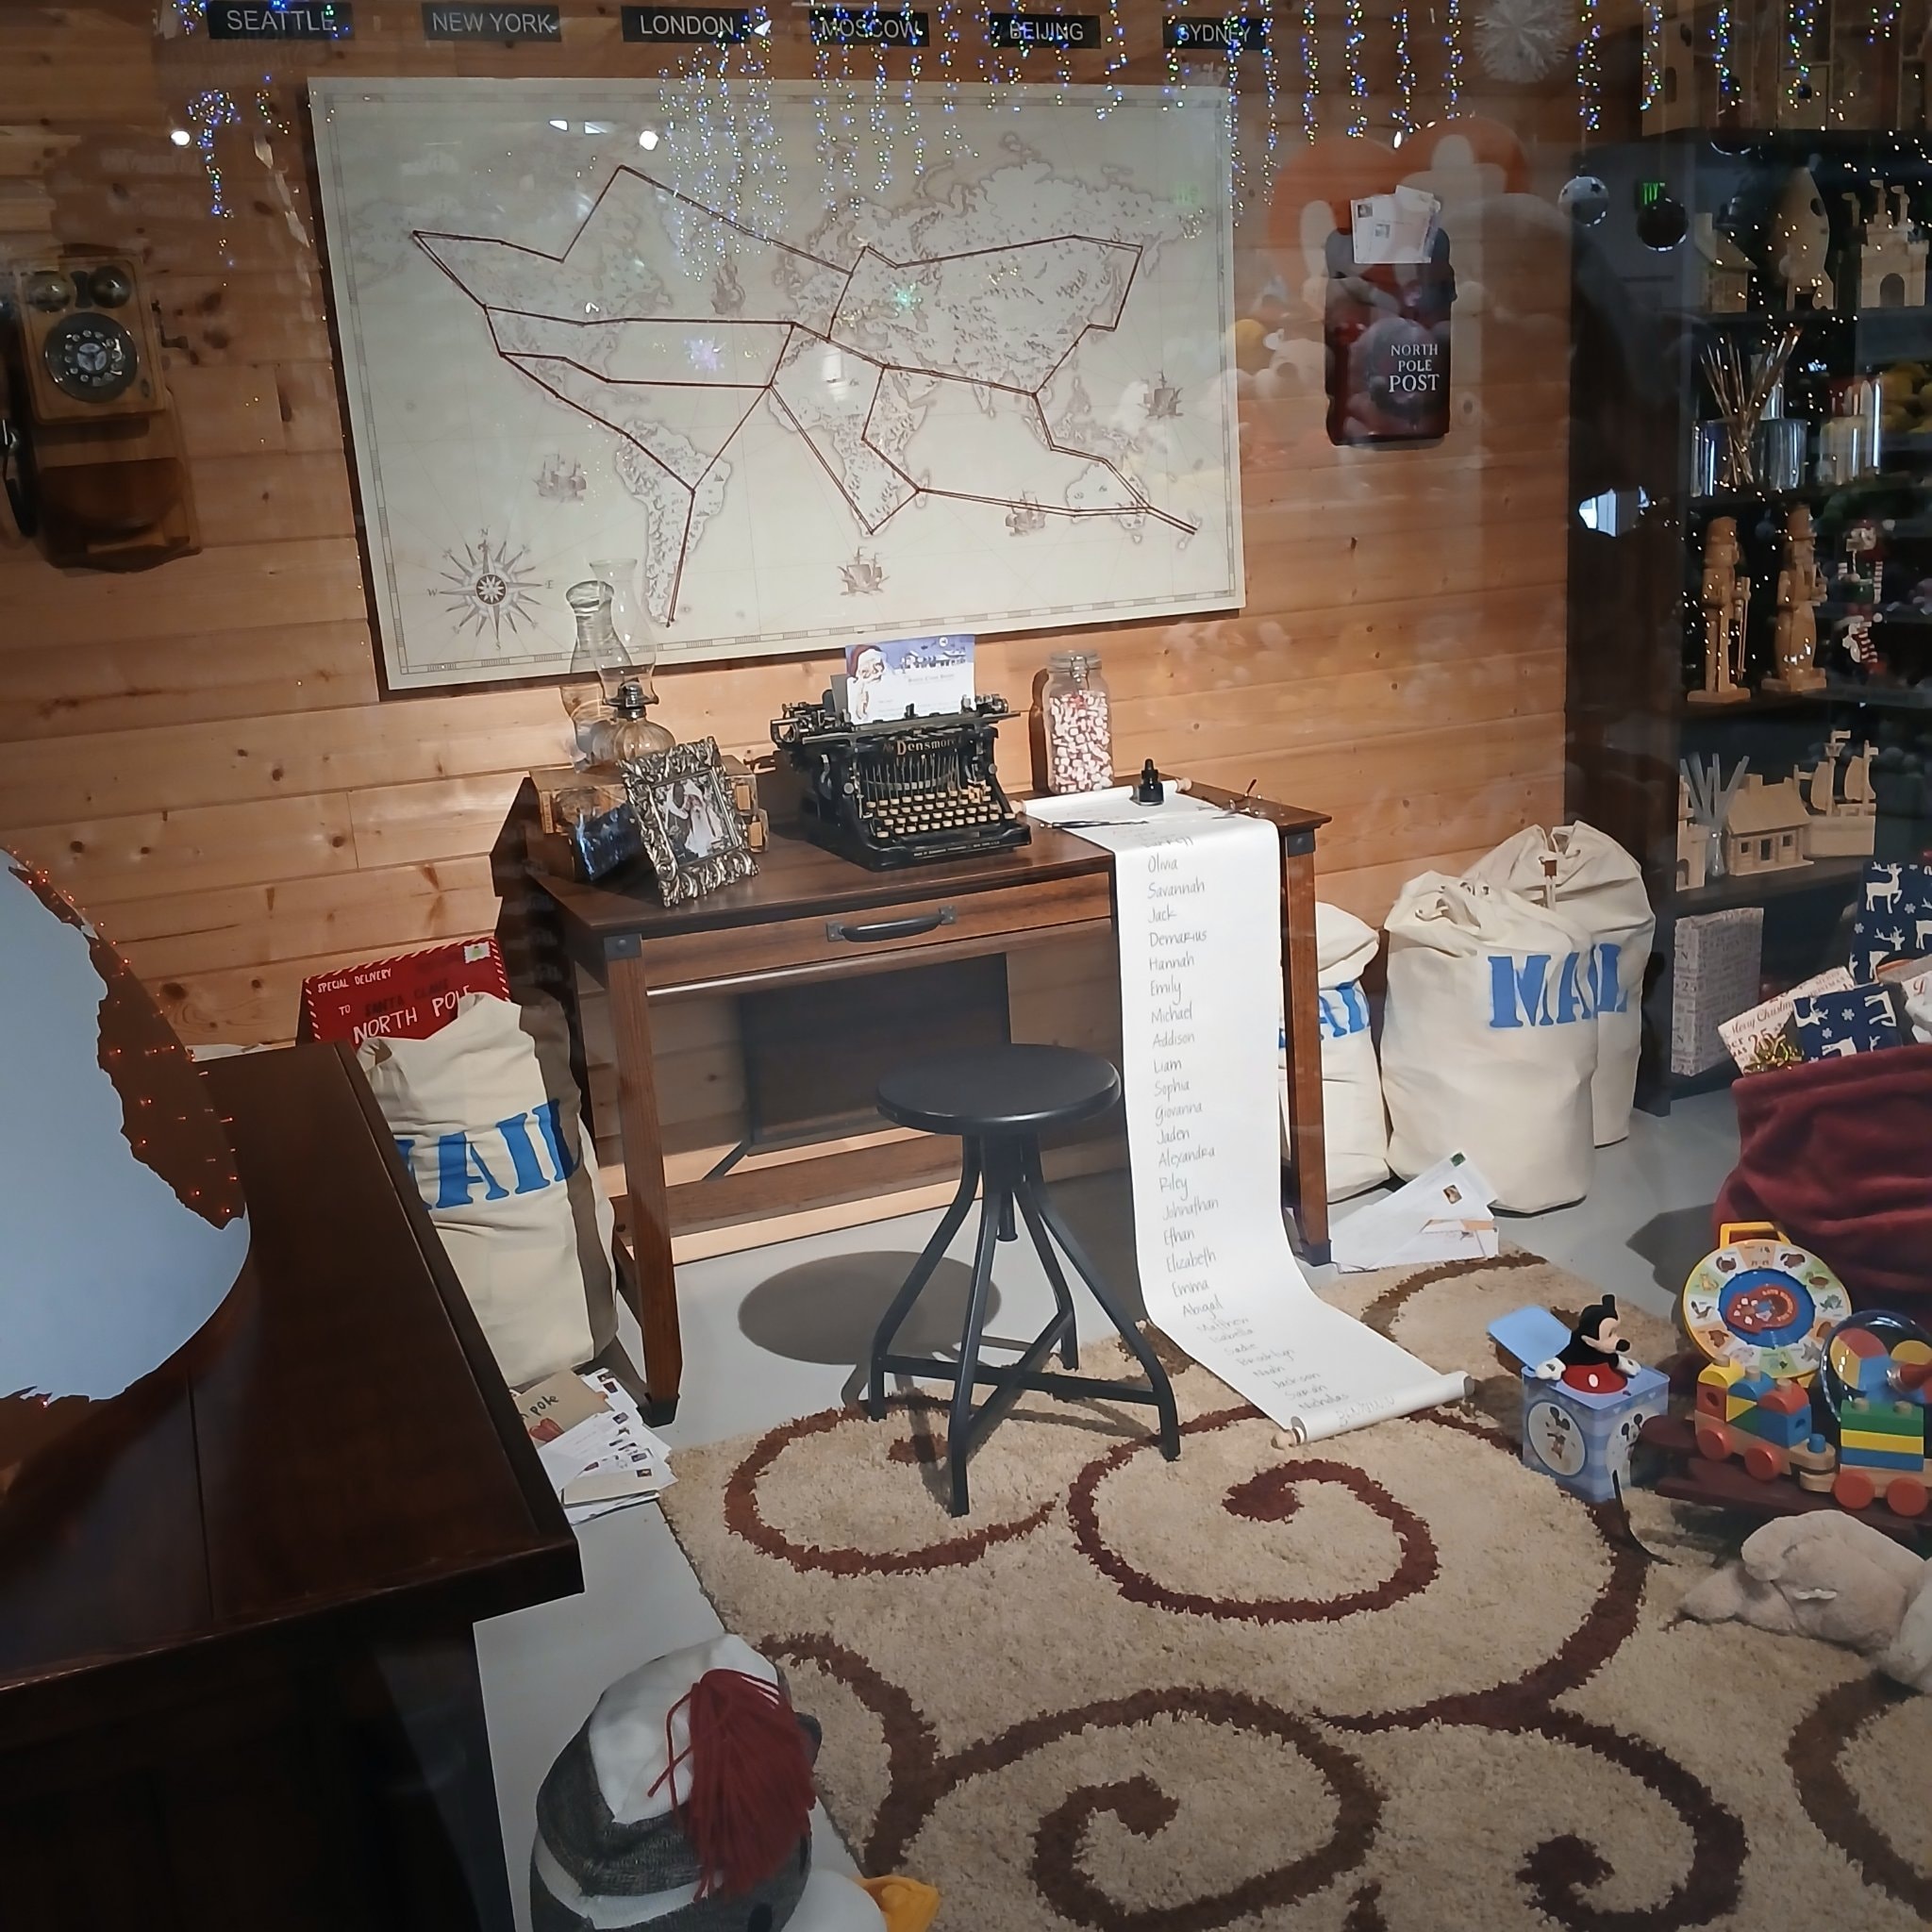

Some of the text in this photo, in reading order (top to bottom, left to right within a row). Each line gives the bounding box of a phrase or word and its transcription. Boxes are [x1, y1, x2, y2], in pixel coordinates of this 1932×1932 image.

[226, 9, 336, 31] SEATTLE
[432, 11, 554, 34] NEW YORK
[640, 14, 735, 35] LONDON
[821, 19, 921, 39] MOSCOW
[1008, 21, 1084, 41] BEIJING
[1177, 24, 1252, 42] SYDNEY
[1391, 343, 1439, 357] NORTH
[1398, 359, 1433, 373] POLE
[1389, 374, 1440, 393] POST
[427, 588, 439, 597] W
[1147, 854, 1178, 873] Olivia
[1147, 876, 1206, 899] Savannah
[1147, 904, 1177, 924] Jack
[1149, 951, 1195, 972] Hannah
[317, 968, 391, 993] SPECIAL DELIVERY
[1150, 975, 1182, 1005] Emily
[339, 1004, 351, 1016] TO
[1151, 1001, 1192, 1024] Michael
[1757, 1000, 1793, 1022] Christm
[353, 1007, 418, 1044] NORTH
[1152, 1030, 1195, 1049] Addison
[1153, 1059, 1182, 1074] Liam
[1154, 1078, 1190, 1102] Sophia
[1155, 1103, 1203, 1126] Giovanna
[1157, 1126, 1191, 1145] Jaden
[1158, 1145, 1216, 1169] Alexandra
[1158, 1173, 1189, 1201] Riley
[1162, 1196, 1219, 1221] Johnathan
[1163, 1226, 1195, 1248] Ethan
[1166, 1246, 1217, 1273] Elizabeth
[1172, 1279, 1209, 1297] Emma
[1182, 1293, 1224, 1320] Abigail
